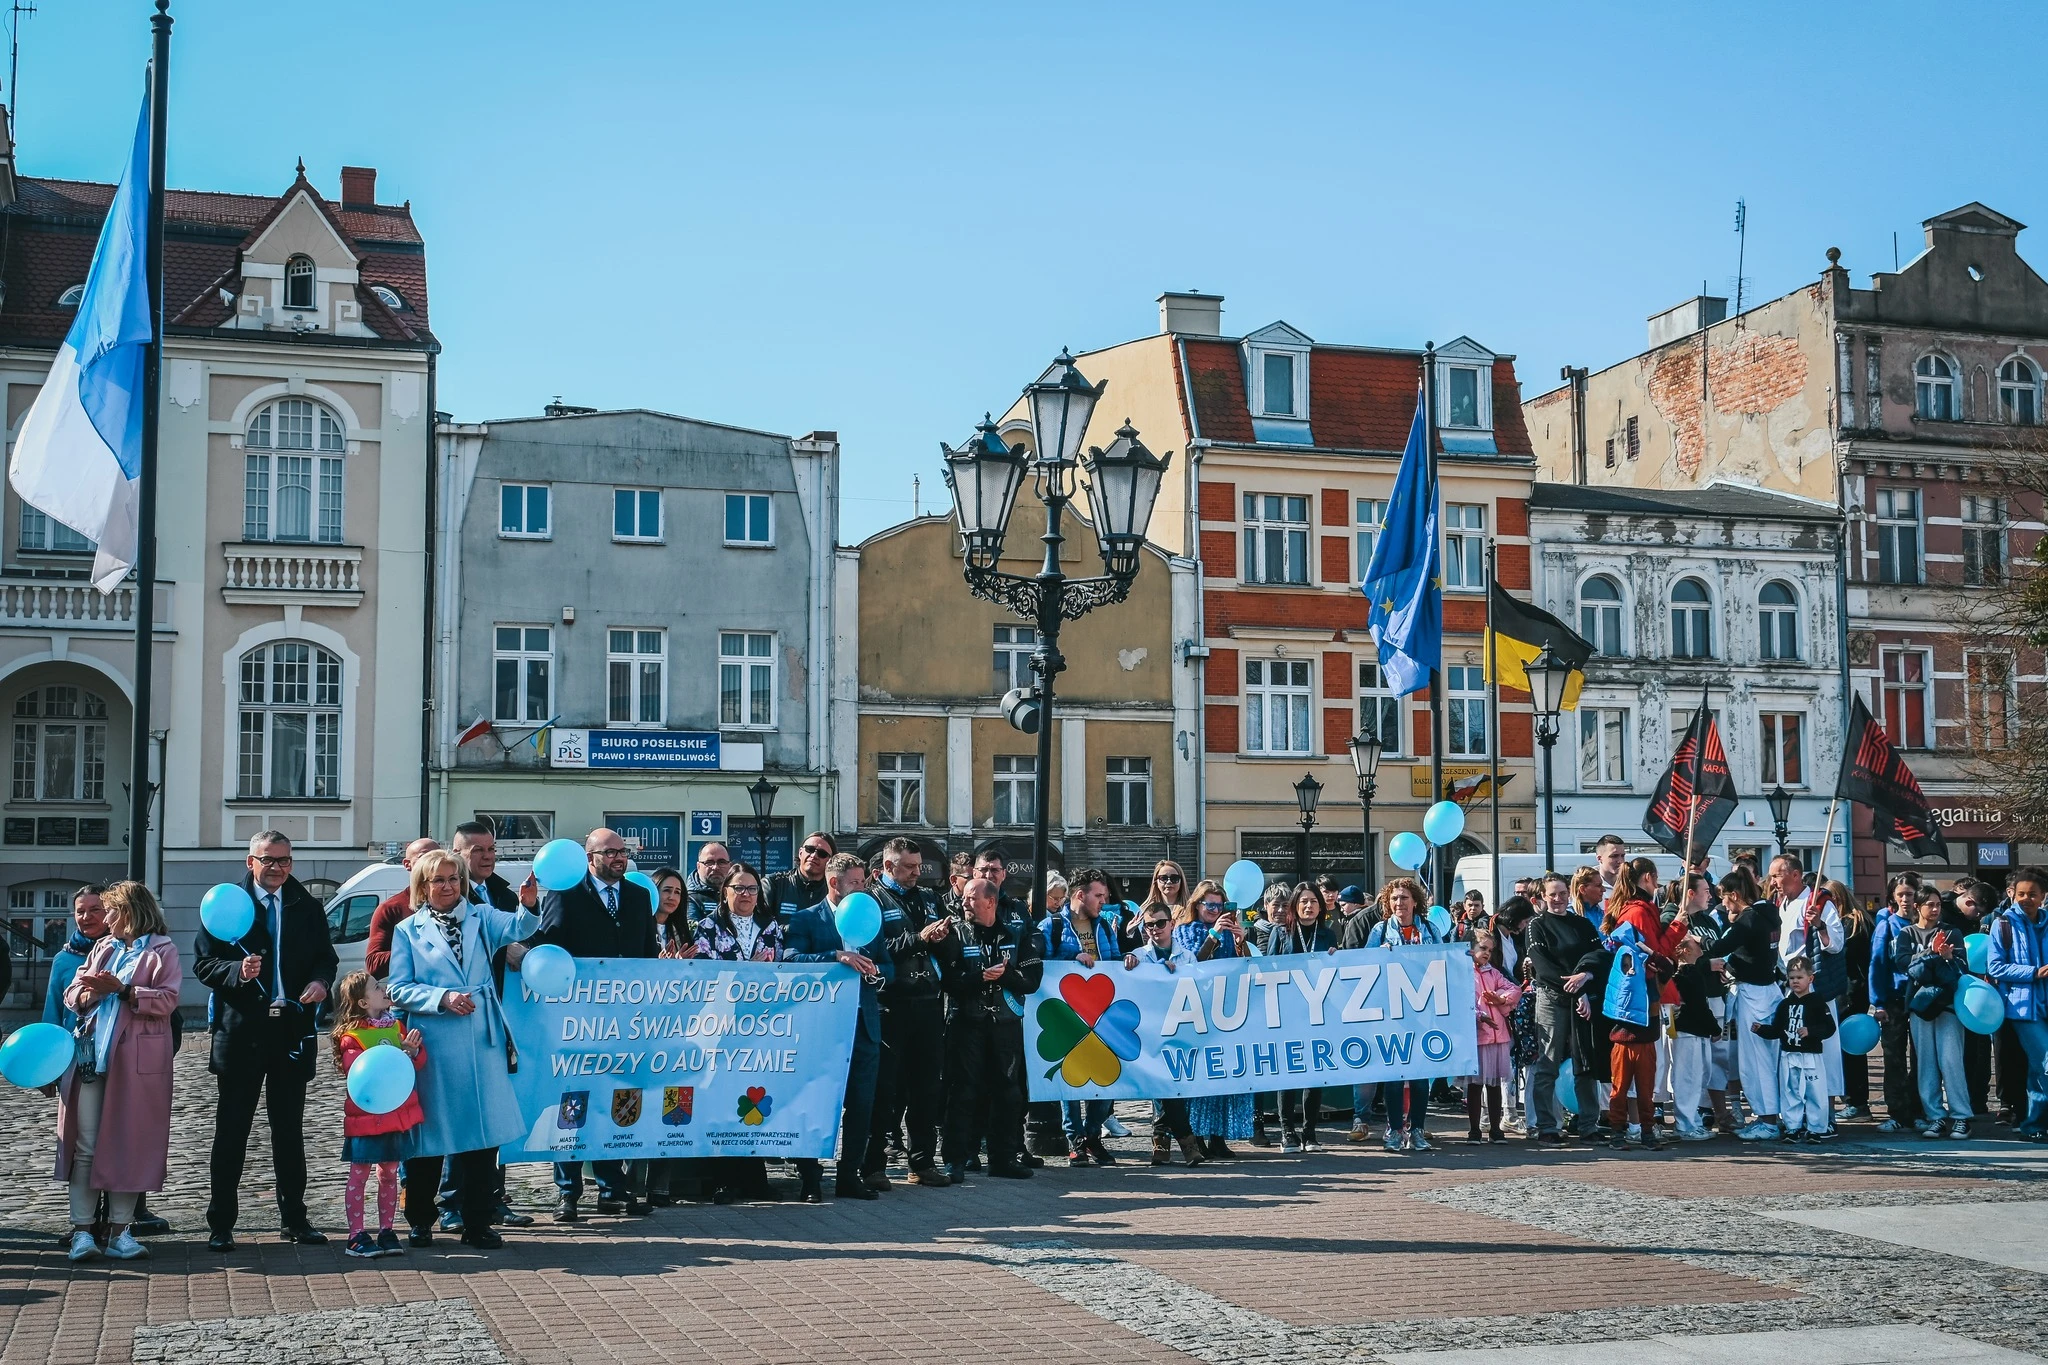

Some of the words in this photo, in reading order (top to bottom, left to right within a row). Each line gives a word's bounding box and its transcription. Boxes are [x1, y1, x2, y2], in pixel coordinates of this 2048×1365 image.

[601, 738, 639, 748] BIURO
[642, 739, 707, 749] POSELSKIE
[633, 752, 716, 762] SPRAWIEDLIWOŚĆ
[701, 818, 712, 834] 9
[1512, 818, 1521, 829] 11
[520, 979, 719, 1004] WJHEROWSKIE
[725, 980, 843, 1003] OBCHODY
[1160, 960, 1450, 1036] AUTYZM
[561, 1016, 621, 1041] DNIA
[627, 1009, 800, 1045] ŚWIADOMOŚCI,
[550, 1051, 646, 1077] WIEDZY
[650, 1050, 668, 1074] O
[671, 1049, 798, 1073] AUTYZMIE
[1161, 1028, 1453, 1082] WEJHEROWO
[549, 1143, 587, 1151] WEJHEROWO
[603, 1141, 643, 1149] WEJHEROWSKI
